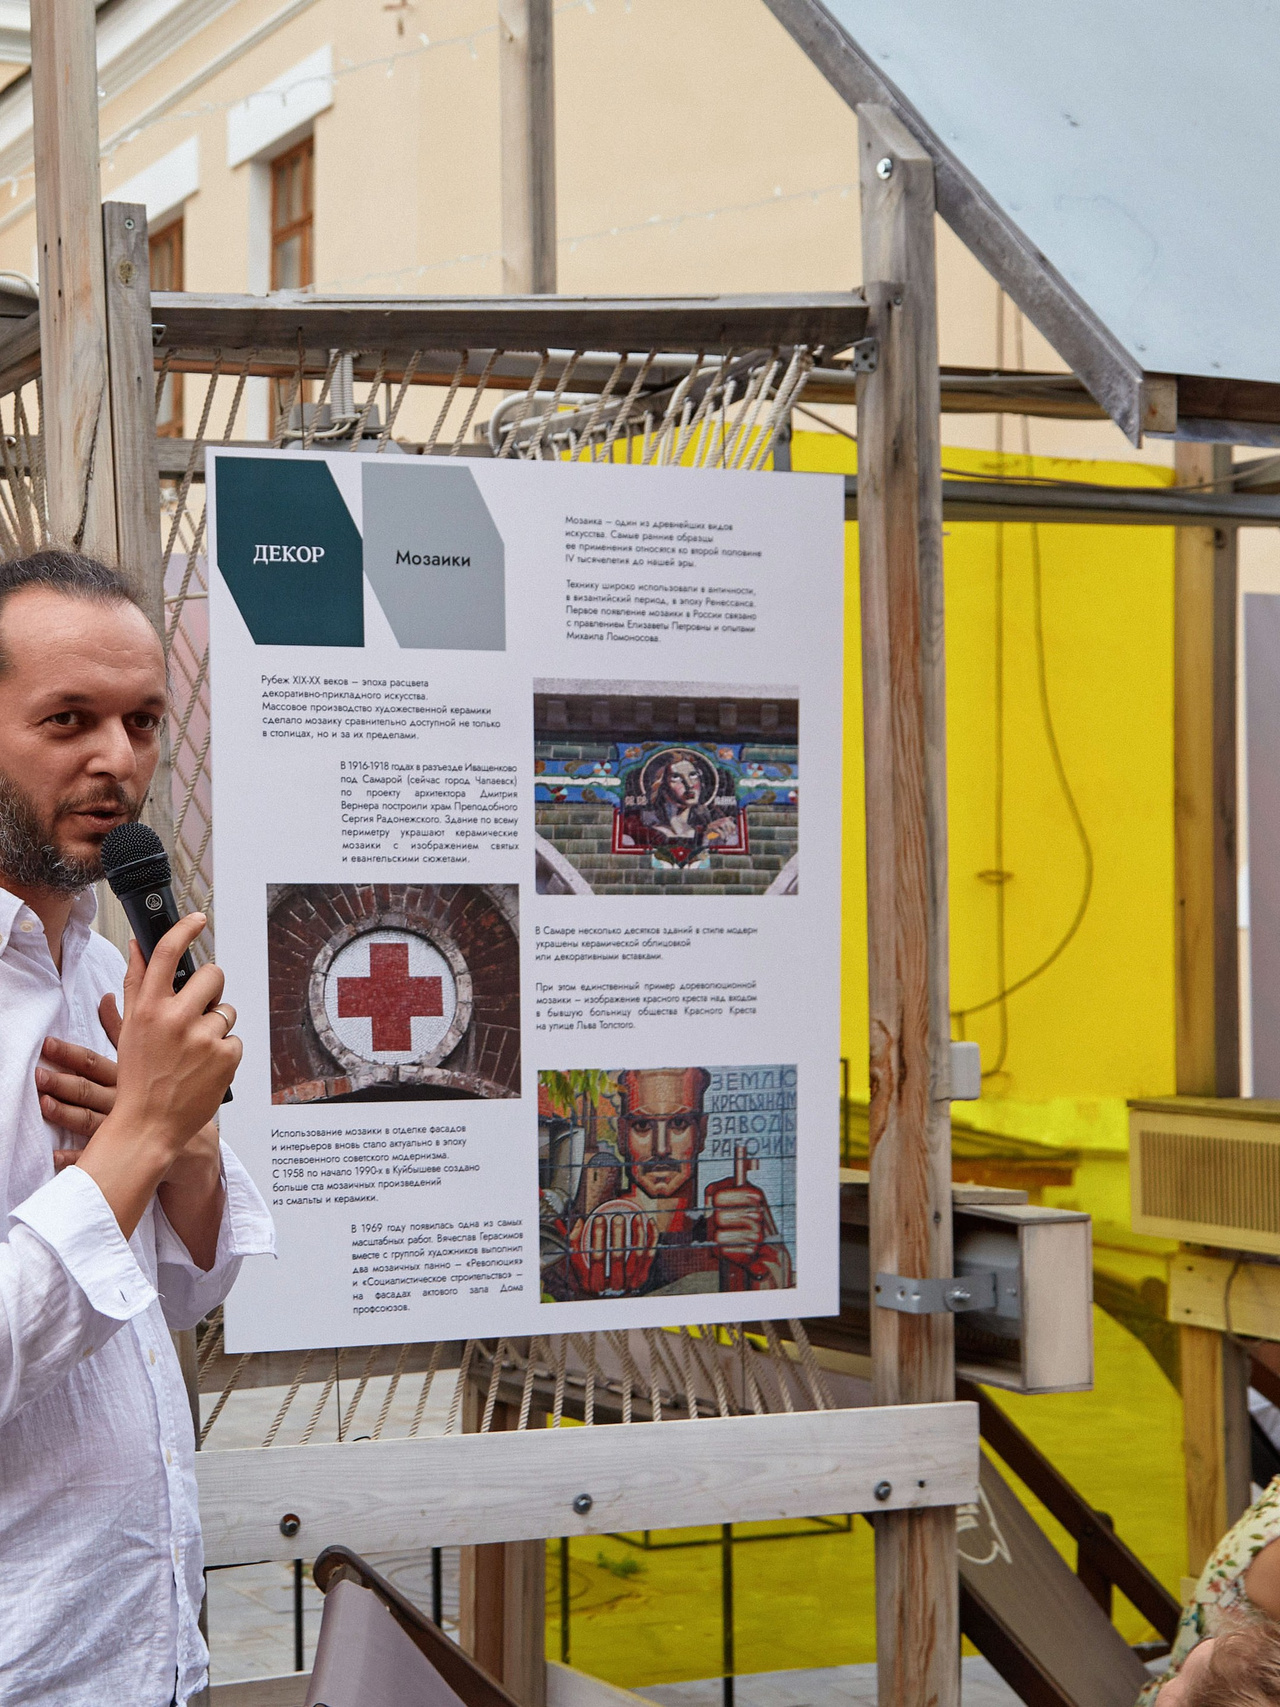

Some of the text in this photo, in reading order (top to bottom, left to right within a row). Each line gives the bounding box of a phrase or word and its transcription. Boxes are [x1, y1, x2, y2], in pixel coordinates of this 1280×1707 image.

[253, 544, 325, 565] ДЕКОР
[396, 550, 471, 567] Мозаики
[261, 674, 290, 686] Рубеж
[389, 680, 429, 689] расцвета
[261, 702, 491, 716] Массовое производство художественной керамики
[262, 717, 303, 725] сделало
[304, 717, 342, 727] мозаику
[344, 718, 407, 728] сравнительно
[409, 717, 456, 729] доступной
[472, 720, 501, 728] только
[391, 764, 414, 772] годах
[422, 764, 463, 773] разъезде
[464, 763, 517, 773] Иващенково
[340, 774, 517, 787] под Самарой (сейчас город Чапаевск)
[340, 789, 518, 800] по проекту архитектора Дмитрия
[340, 800, 518, 812] Вернера построили храм Преподобного
[341, 813, 374, 825] Сергия
[444, 814, 478, 825] Здание
[493, 817, 518, 826] всему
[341, 829, 518, 838] периметру украшают керамические
[410, 840, 479, 851] изображением
[350, 855, 420, 863] евангельскими
[712, 1069, 796, 1091] ЗЕМЛЮ
[271, 1127, 343, 1138] Использование
[344, 1128, 382, 1136] мозаики
[392, 1126, 427, 1135] отделке
[429, 1125, 466, 1134] фасадов
[280, 1143, 332, 1153] интерьеров
[362, 1141, 387, 1149] стало
[389, 1140, 433, 1149] актуально
[442, 1138, 467, 1148] эпоху
[271, 1156, 341, 1165] послевоенного
[342, 1154, 390, 1163] советского
[282, 1168, 304, 1178] 1958
[320, 1169, 352, 1177] начало
[392, 1163, 441, 1176] Куйбышеве
[443, 1164, 480, 1173] создано
[272, 1177, 441, 1192] больше ста мозаичных произведений
[272, 1198, 284, 1206] из
[285, 1197, 323, 1205] смальты
[361, 1222, 383, 1233] 1969
[387, 1224, 406, 1233] году
[409, 1222, 454, 1231] появилась
[457, 1221, 480, 1229] одна
[497, 1219, 522, 1227] самых
[351, 1235, 404, 1247] масштабных
[436, 1232, 477, 1243] Вячеслав
[479, 1230, 523, 1242] Герасимов
[352, 1266, 369, 1274] два
[372, 1263, 420, 1273] мозаичных
[424, 1262, 451, 1270] панно
[352, 1283, 524, 1301] на фасадах актового зала Дома
